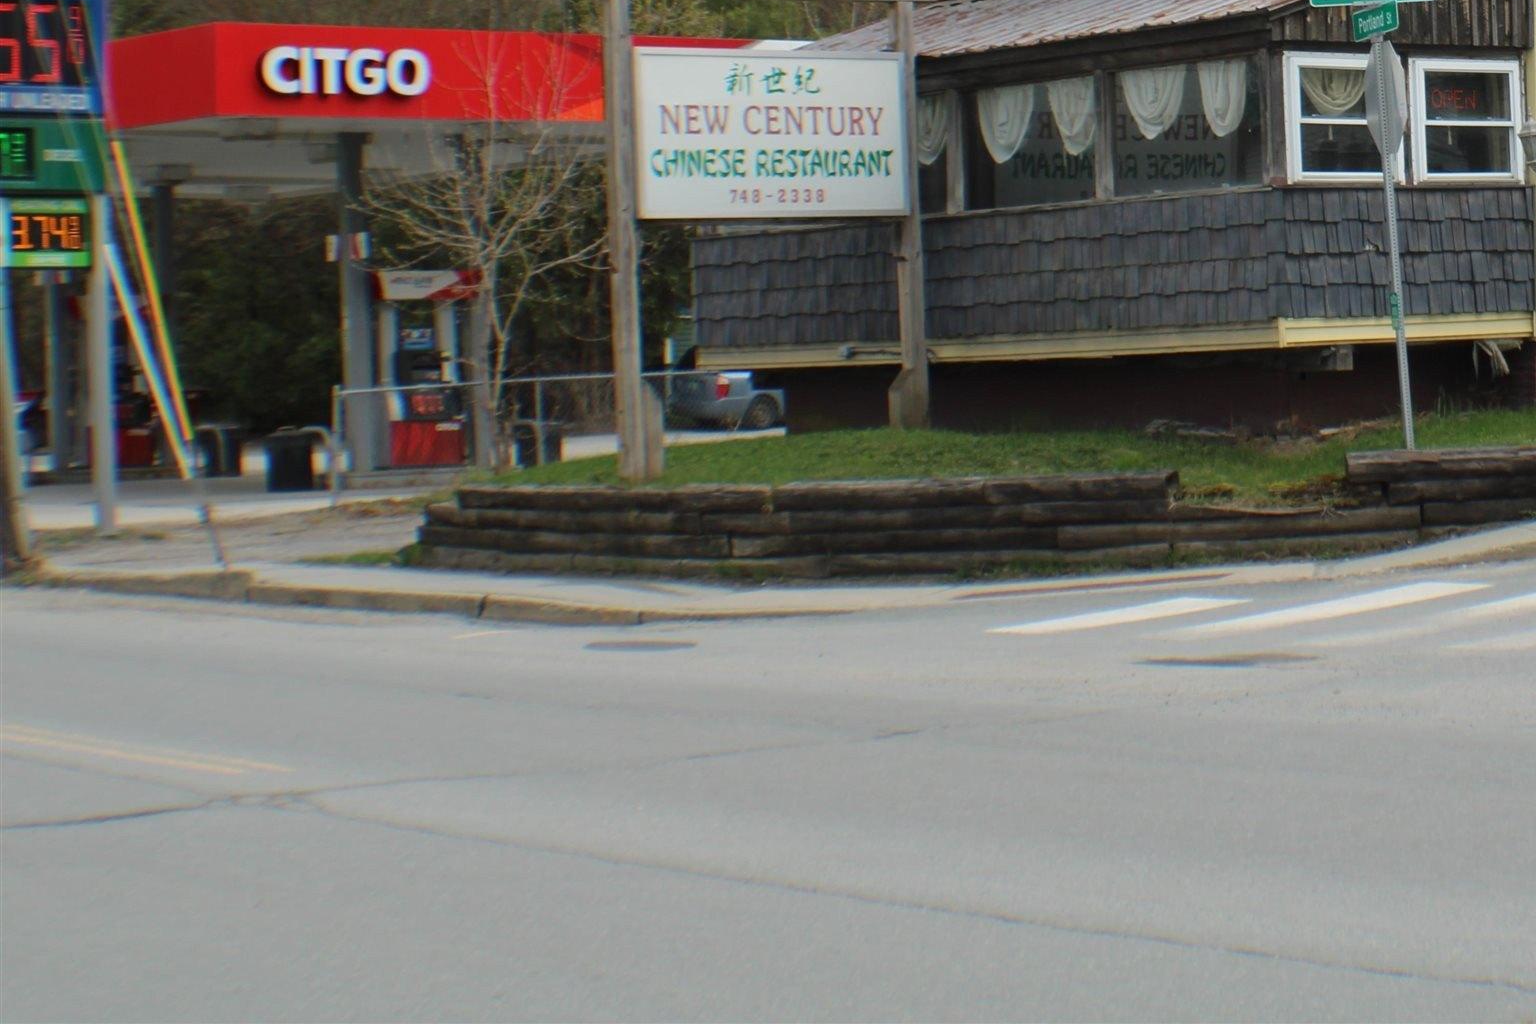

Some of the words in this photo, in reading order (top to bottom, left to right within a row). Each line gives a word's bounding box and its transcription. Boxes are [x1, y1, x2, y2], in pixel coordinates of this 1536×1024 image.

[1358, 11, 1384, 33] Portland
[262, 46, 431, 96] CITGO
[724, 63, 821, 96] 新世紀
[659, 104, 730, 135] NEW
[743, 105, 884, 137] CENTURY
[651, 148, 747, 178] CHINESE
[755, 149, 894, 177] RESTAURANT
[729, 188, 826, 204] 748-2338
